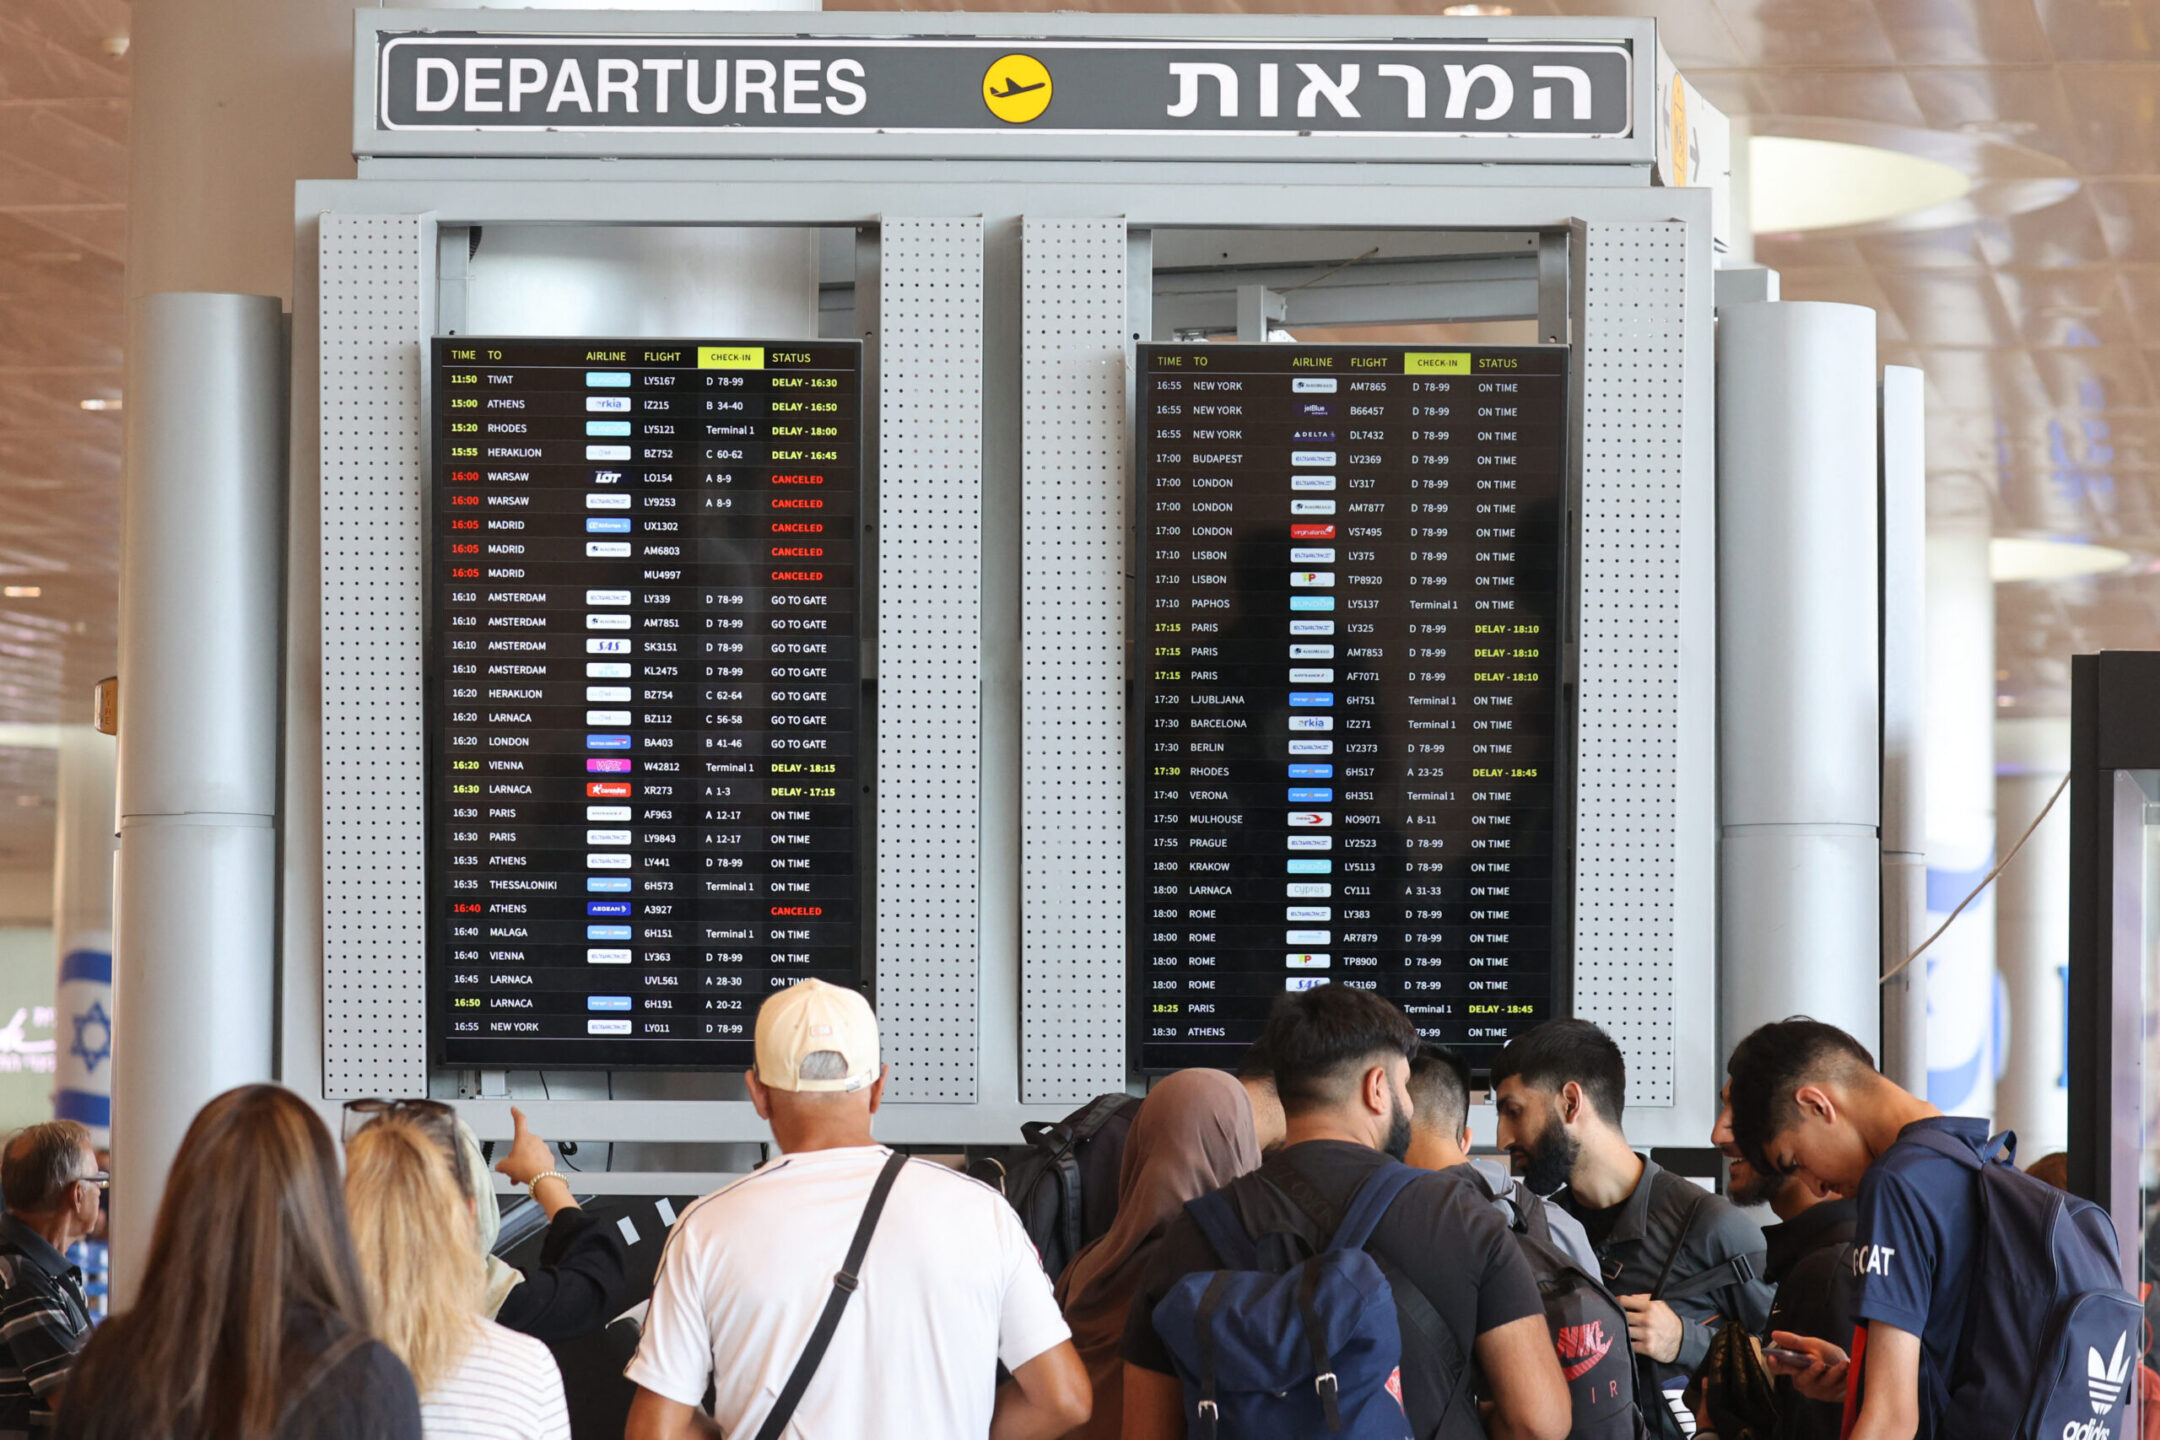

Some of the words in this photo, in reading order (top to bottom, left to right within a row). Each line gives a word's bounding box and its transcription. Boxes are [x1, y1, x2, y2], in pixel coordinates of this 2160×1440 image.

[416, 57, 867, 116] DEPARTURES
[1167, 62, 1592, 121] המראות
[451, 350, 476, 361] TIME
[487, 350, 502, 361] TO
[586, 351, 627, 362] AIRLINE
[643, 351, 681, 362] FLIGHT
[710, 352, 751, 362] CHECK-IN
[771, 353, 812, 364] STATUS
[1157, 356, 1182, 367] TIME
[1193, 356, 1208, 367] TO
[1292, 356, 1333, 367] AIRLINE
[1350, 357, 1388, 368] FLIGHT
[1417, 358, 1458, 368] CHECK-IN
[1478, 358, 1518, 369] STATUS
[487, 374, 514, 384] TIVAT
[643, 376, 676, 386] LY5167
[1193, 381, 1215, 391] NEW
[1217, 381, 1243, 391] YORK
[1350, 382, 1387, 392] AM7865
[487, 399, 526, 409] ATHENS
[643, 400, 670, 410] IZ215
[1193, 405, 1214, 415] NEW
[1217, 405, 1243, 415] YORK
[1350, 406, 1385, 416] B66457
[487, 423, 528, 434] RHODES
[643, 424, 675, 434] LY5121
[1193, 429, 1214, 440] NEW
[1217, 429, 1242, 440] YORK
[1349, 430, 1384, 440] DL7432
[487, 447, 542, 458] HERAKLION
[643, 448, 673, 459] BZ752
[1192, 454, 1243, 464] BUDAPEST
[1349, 454, 1382, 465] LY2369
[487, 471, 530, 482] WARSAW
[643, 473, 673, 483] LO154
[771, 474, 824, 485] CANCELED
[1192, 478, 1233, 488] LONDON
[1349, 479, 1376, 489] LY317
[487, 496, 530, 506] WARSAW
[643, 497, 676, 507] LY9253
[771, 498, 824, 509] CANCELED
[1192, 502, 1233, 512] LONDON
[1348, 503, 1385, 513] AM7877
[487, 520, 525, 530] MADRID
[643, 521, 679, 531] UX1302
[771, 523, 824, 533] CANCELED
[1192, 526, 1233, 536] LONDON
[1348, 527, 1383, 537] VS7495
[488, 544, 525, 554] MADRID
[643, 546, 681, 556] AM6803
[771, 547, 824, 557] CANCELED
[1191, 550, 1227, 561] LISBON
[1348, 551, 1375, 561] LY375
[488, 568, 525, 578] MADRID
[643, 570, 682, 580] MU4997
[771, 571, 824, 581] CANCELED
[1191, 574, 1227, 585] LISBON
[1347, 575, 1383, 585] TP8920
[487, 592, 547, 602] AMSTERDAM
[643, 594, 671, 604] LY339
[1191, 598, 1230, 609] PAPHOS
[1347, 599, 1380, 609] LY5137
[487, 617, 547, 627] AMSTERDAM
[643, 618, 680, 628] AM7851
[1191, 622, 1219, 633] PARIS
[1347, 623, 1374, 633] LY325
[488, 641, 547, 651] AMSTERDAM
[644, 642, 678, 652] SK3151
[1191, 646, 1219, 657] PARIS
[1346, 648, 1383, 658] AM7853
[488, 665, 547, 675] AMSTERDAM
[644, 666, 678, 676] KL2475
[1191, 670, 1218, 681] PARIS
[1346, 671, 1380, 681] AF7071
[488, 688, 543, 699] HERAKLION
[644, 690, 674, 700] BZ754
[1190, 695, 1245, 705] LJUBLJANA
[1346, 695, 1376, 705] 6H751
[488, 713, 532, 723] LARNACA
[644, 713, 673, 724] BZ112
[1190, 718, 1248, 729] BARCELONA
[1346, 719, 1372, 729] IZ271
[488, 736, 530, 747] LONDON
[644, 737, 674, 748] BA403
[1190, 742, 1225, 752] BERLIN
[1346, 743, 1378, 753] LY2373
[488, 760, 524, 770] VIENNA
[643, 762, 680, 772] W42812
[1190, 767, 1230, 777] RHODES
[1345, 767, 1375, 777] 6H517
[489, 784, 533, 794] LARNACA
[644, 785, 673, 796] XR273
[1189, 790, 1229, 800] VERONA
[1345, 791, 1374, 801] 6H351
[489, 808, 517, 818] PARIS
[643, 809, 673, 820] AF963
[1189, 814, 1243, 824] MULHOUSE
[1345, 814, 1381, 824] NO9071
[489, 832, 517, 842] PARIS
[644, 833, 677, 844] LY9843
[1189, 838, 1228, 848] PRAGUE
[1344, 838, 1377, 848] LY2523
[488, 855, 527, 866] ATHENS
[644, 857, 670, 867] LY441
[1189, 862, 1230, 872] KRAKOW
[1344, 862, 1376, 872] LY5113
[489, 879, 558, 890] THESSALONIKI
[643, 881, 674, 891] 6H573
[1189, 885, 1233, 895] LARNACA
[1343, 886, 1371, 896] CY111
[489, 903, 528, 914] ATHENS
[643, 905, 673, 915] A3927
[770, 906, 823, 916] CANCELED
[1188, 909, 1217, 919] ROME
[1343, 909, 1371, 919] LY383
[489, 927, 529, 937] MALAGA
[644, 928, 673, 938] 6H151
[1188, 933, 1216, 943] ROME
[1343, 933, 1378, 943] AR7879
[489, 951, 525, 961] VIENNA
[644, 952, 671, 962] LY363
[1188, 956, 1216, 966] ROME
[1343, 956, 1378, 966] TP8900
[490, 974, 533, 985] LARNACA
[644, 975, 679, 986] UVL561
[1188, 980, 1216, 990] ROME
[490, 998, 533, 1008] LARNACA
[644, 999, 673, 1009] 6H191
[1188, 1003, 1216, 1013] PARIS
[490, 1022, 511, 1032] NEW
[514, 1022, 539, 1032] YORK
[644, 1023, 670, 1033] LY011
[1187, 1027, 1226, 1037] ATHENS
[1557, 1320, 1608, 1359] NIKE
[1591, 1380, 1618, 1404] IR
